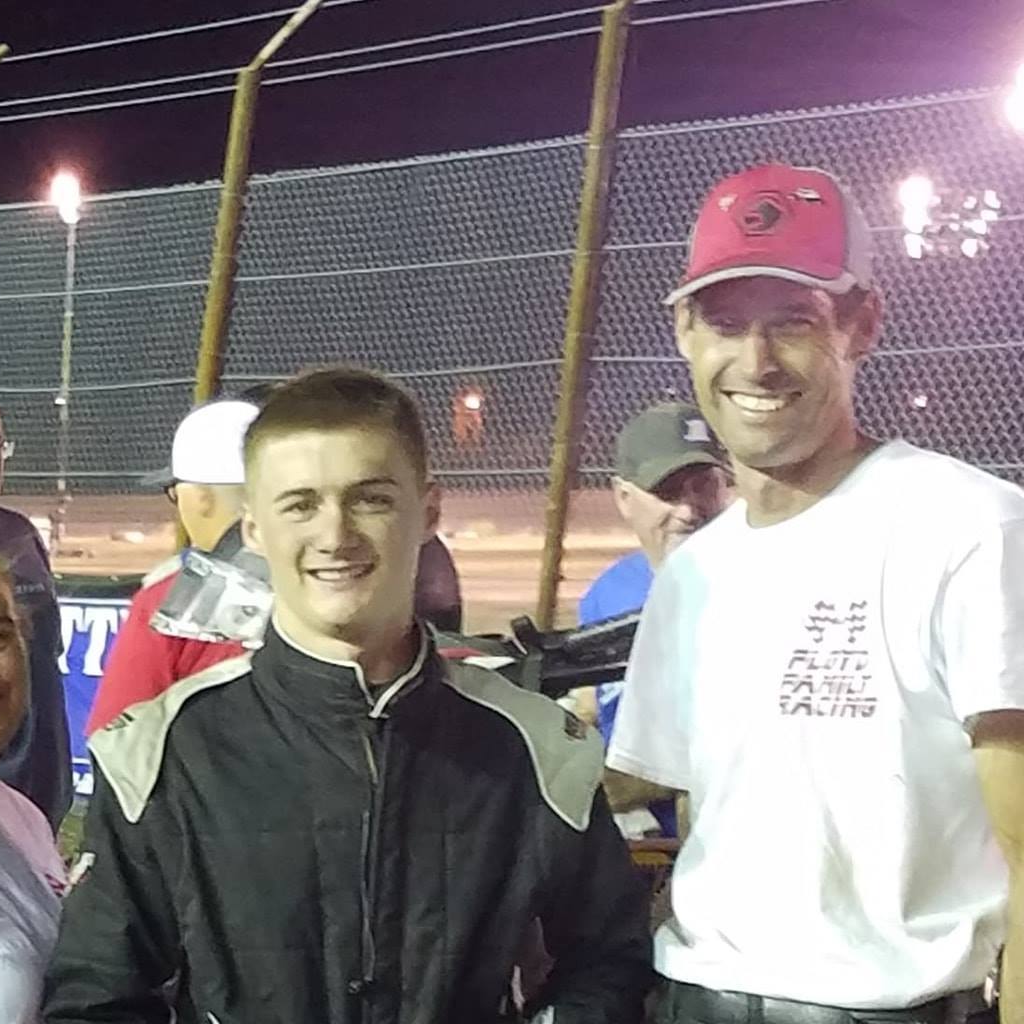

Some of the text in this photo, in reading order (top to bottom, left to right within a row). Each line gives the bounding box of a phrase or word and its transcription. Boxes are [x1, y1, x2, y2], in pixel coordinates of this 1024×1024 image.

[788, 650, 869, 671] FLOYD
[781, 673, 873, 694] FAMILY
[779, 695, 878, 718] RACING
